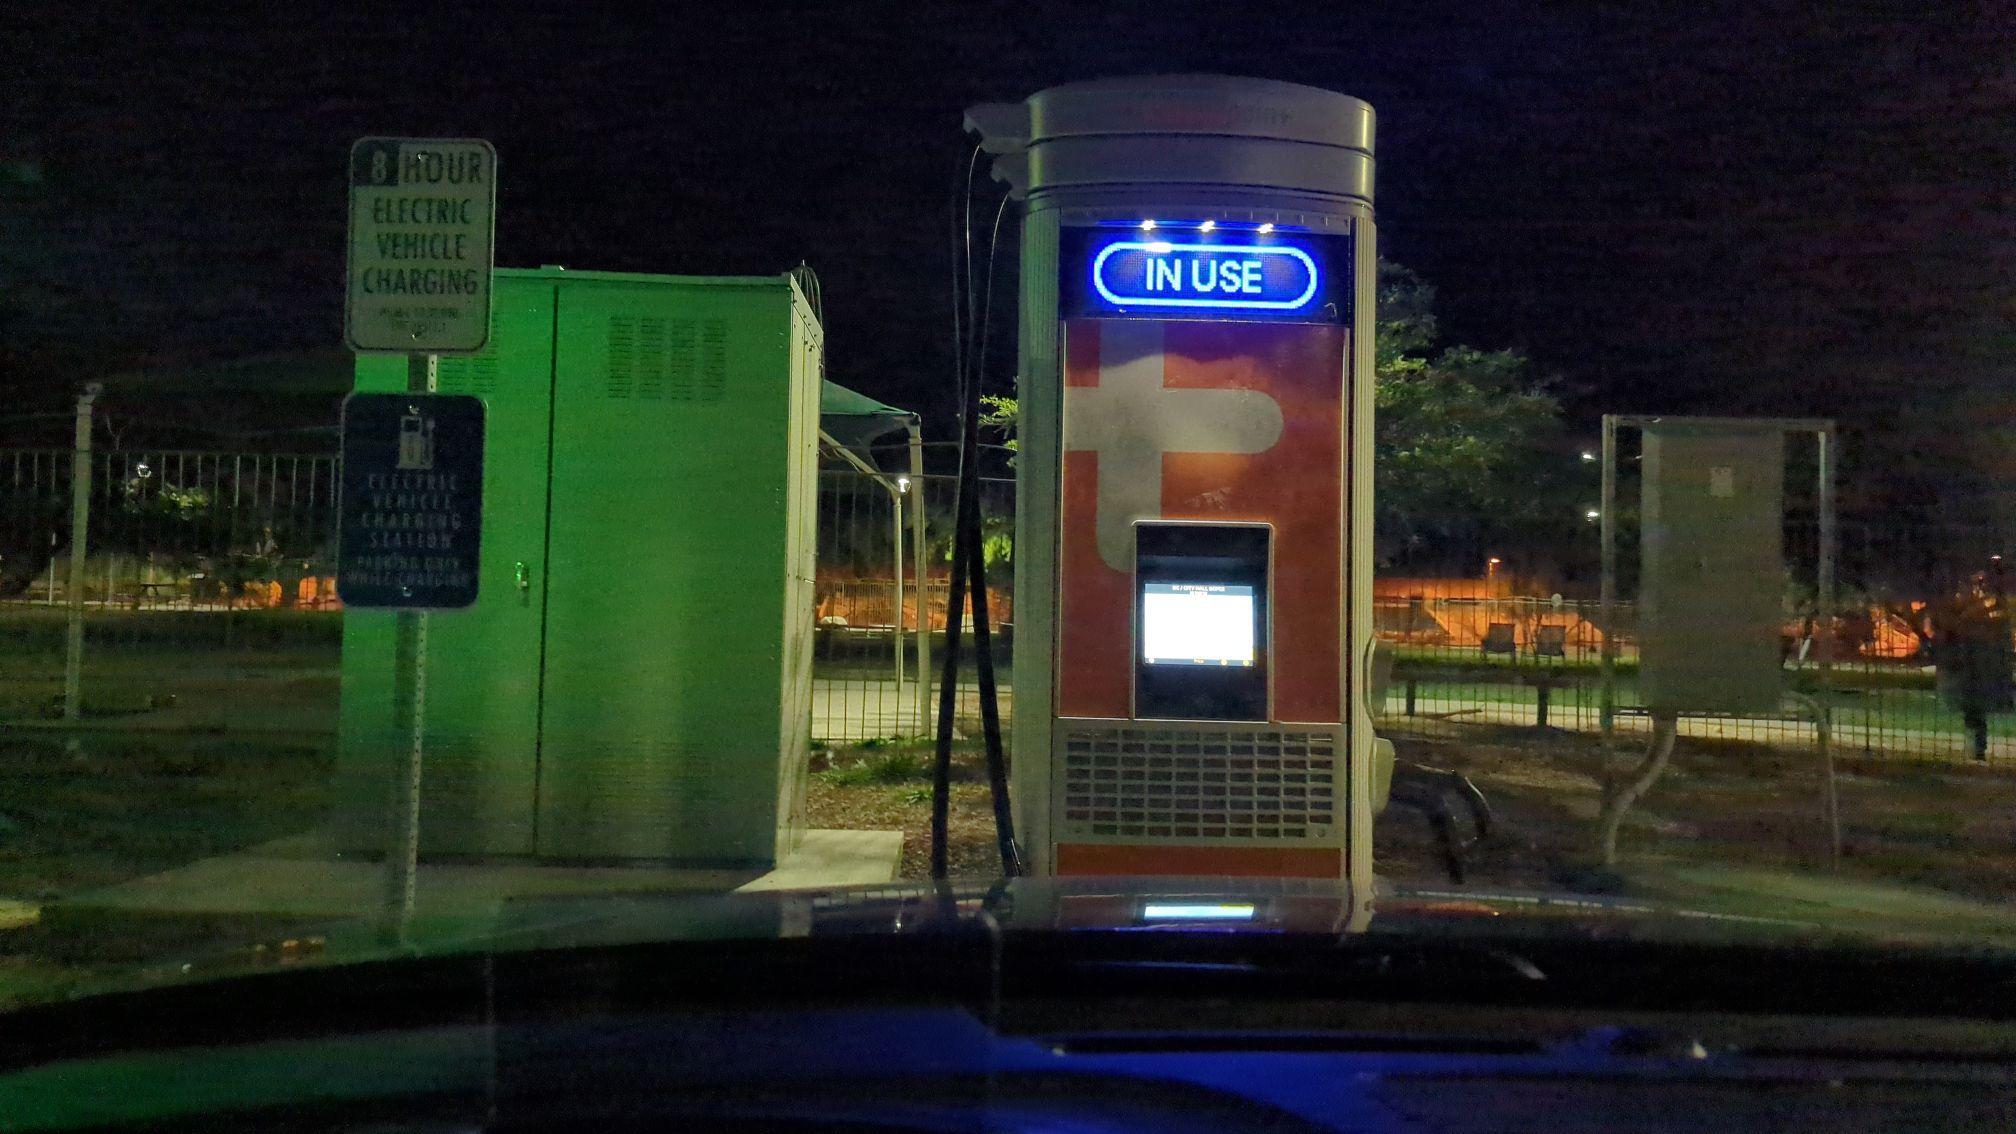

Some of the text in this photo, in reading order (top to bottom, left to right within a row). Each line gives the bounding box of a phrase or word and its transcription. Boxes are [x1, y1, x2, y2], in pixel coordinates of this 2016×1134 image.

[402, 151, 483, 184] HOUR
[373, 198, 472, 224] ELECTRIC
[376, 233, 467, 260] VEHICLE
[362, 267, 478, 295] CHARGING
[1146, 258, 1262, 294] IN USE
